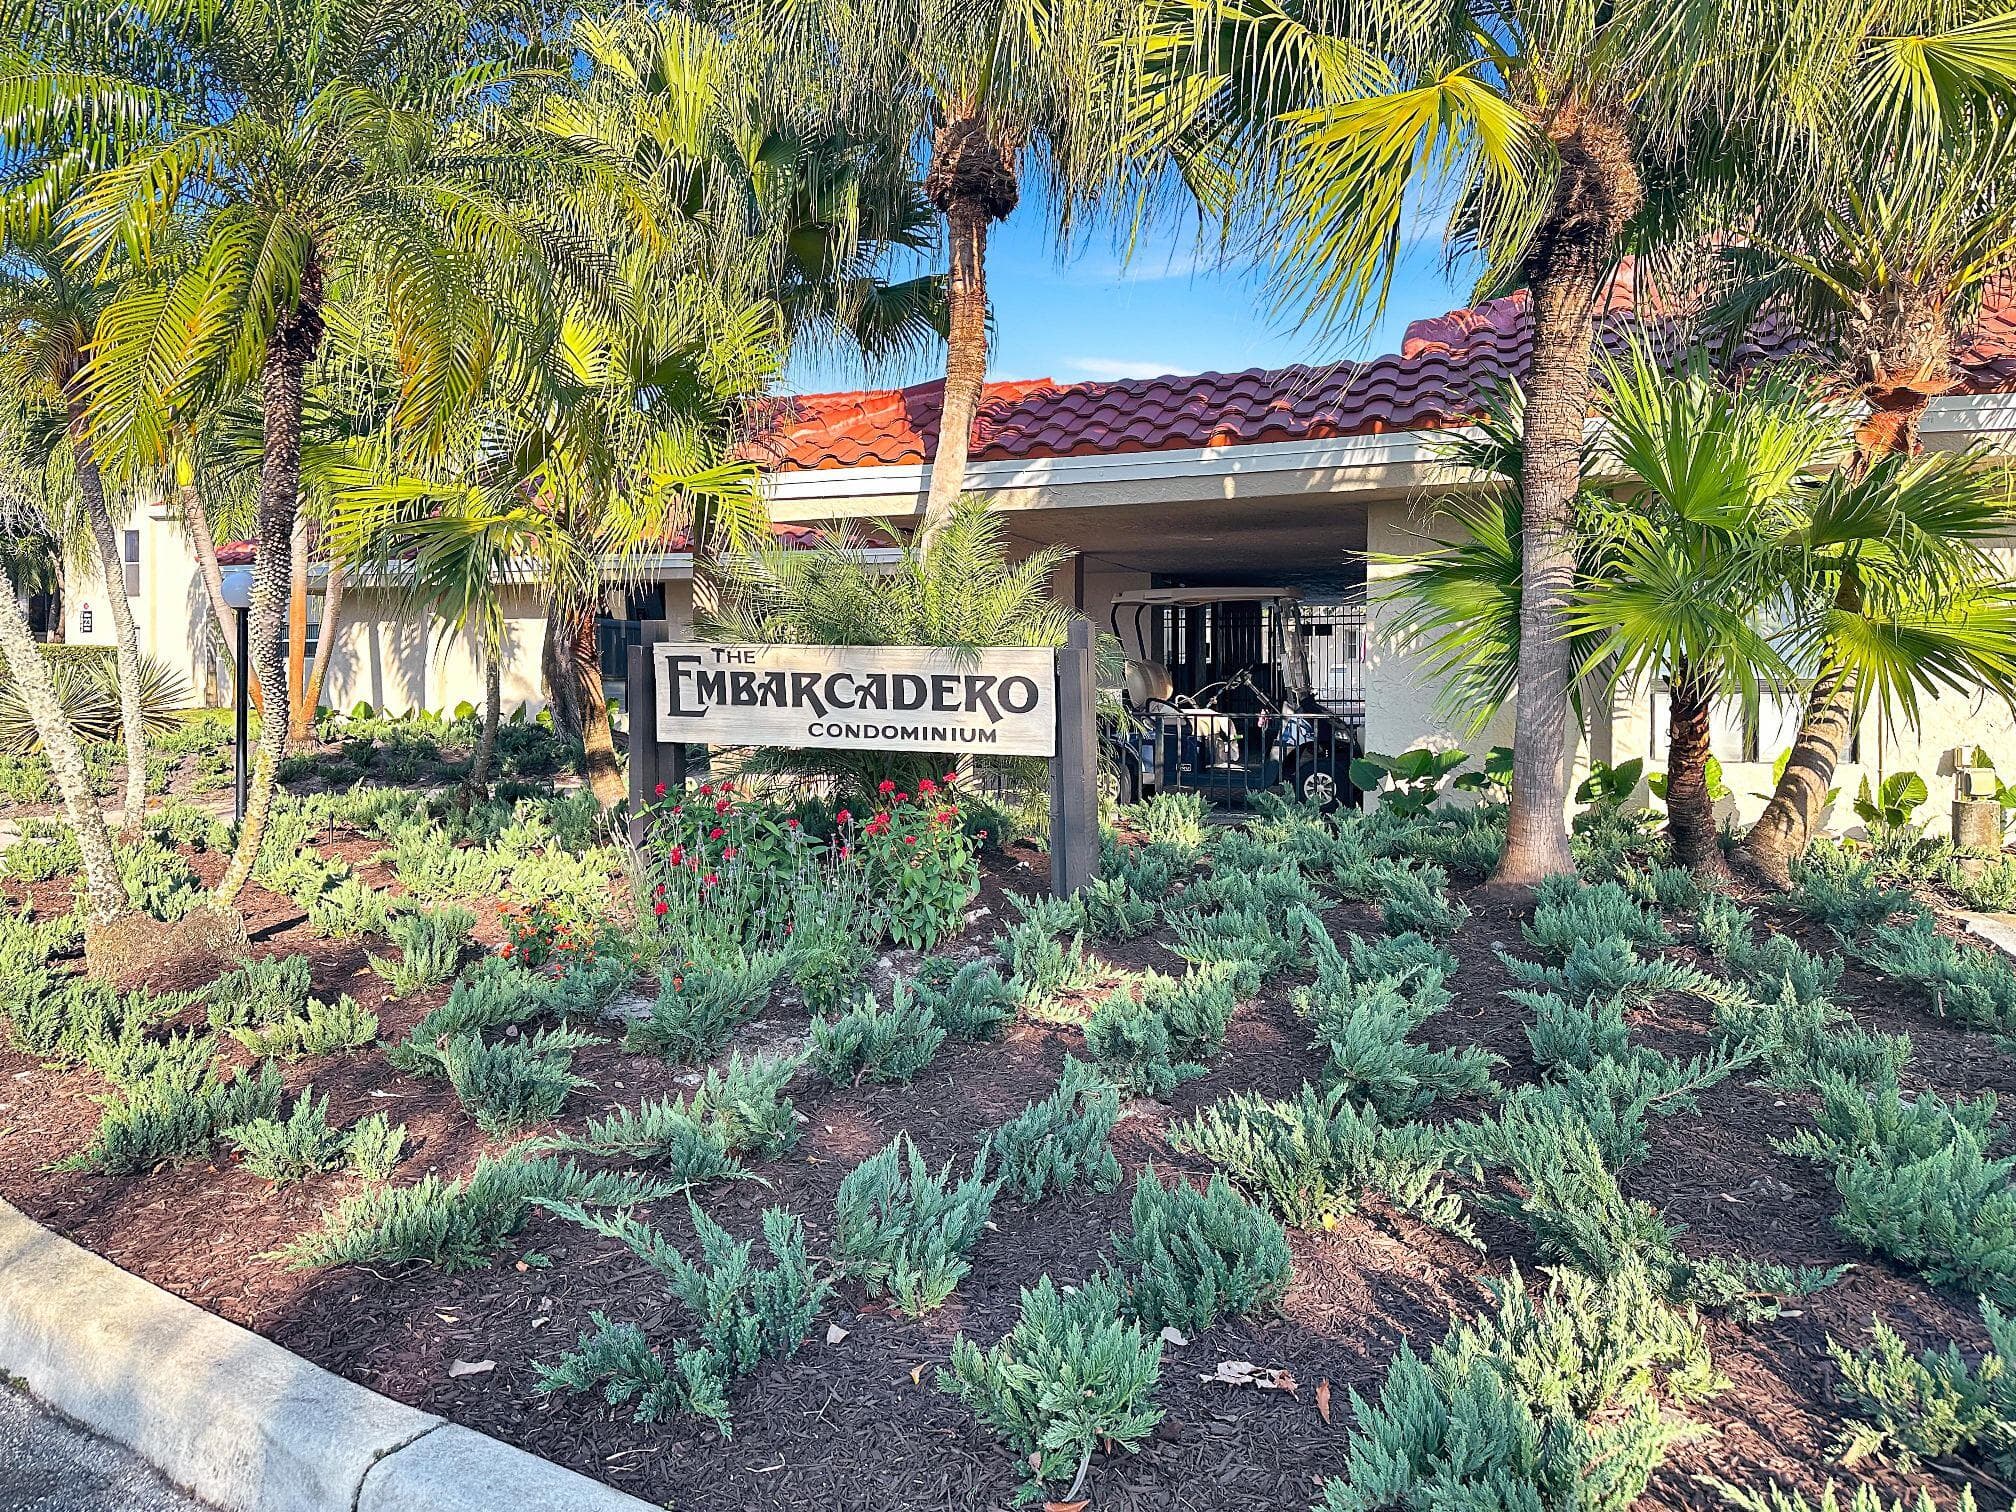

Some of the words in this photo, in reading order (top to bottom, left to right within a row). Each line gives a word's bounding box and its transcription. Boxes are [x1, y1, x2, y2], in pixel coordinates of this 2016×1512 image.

[711, 647, 756, 665] THE
[665, 655, 1039, 724] EMBARCADERO
[808, 722, 997, 743] CONDOMINIUM
